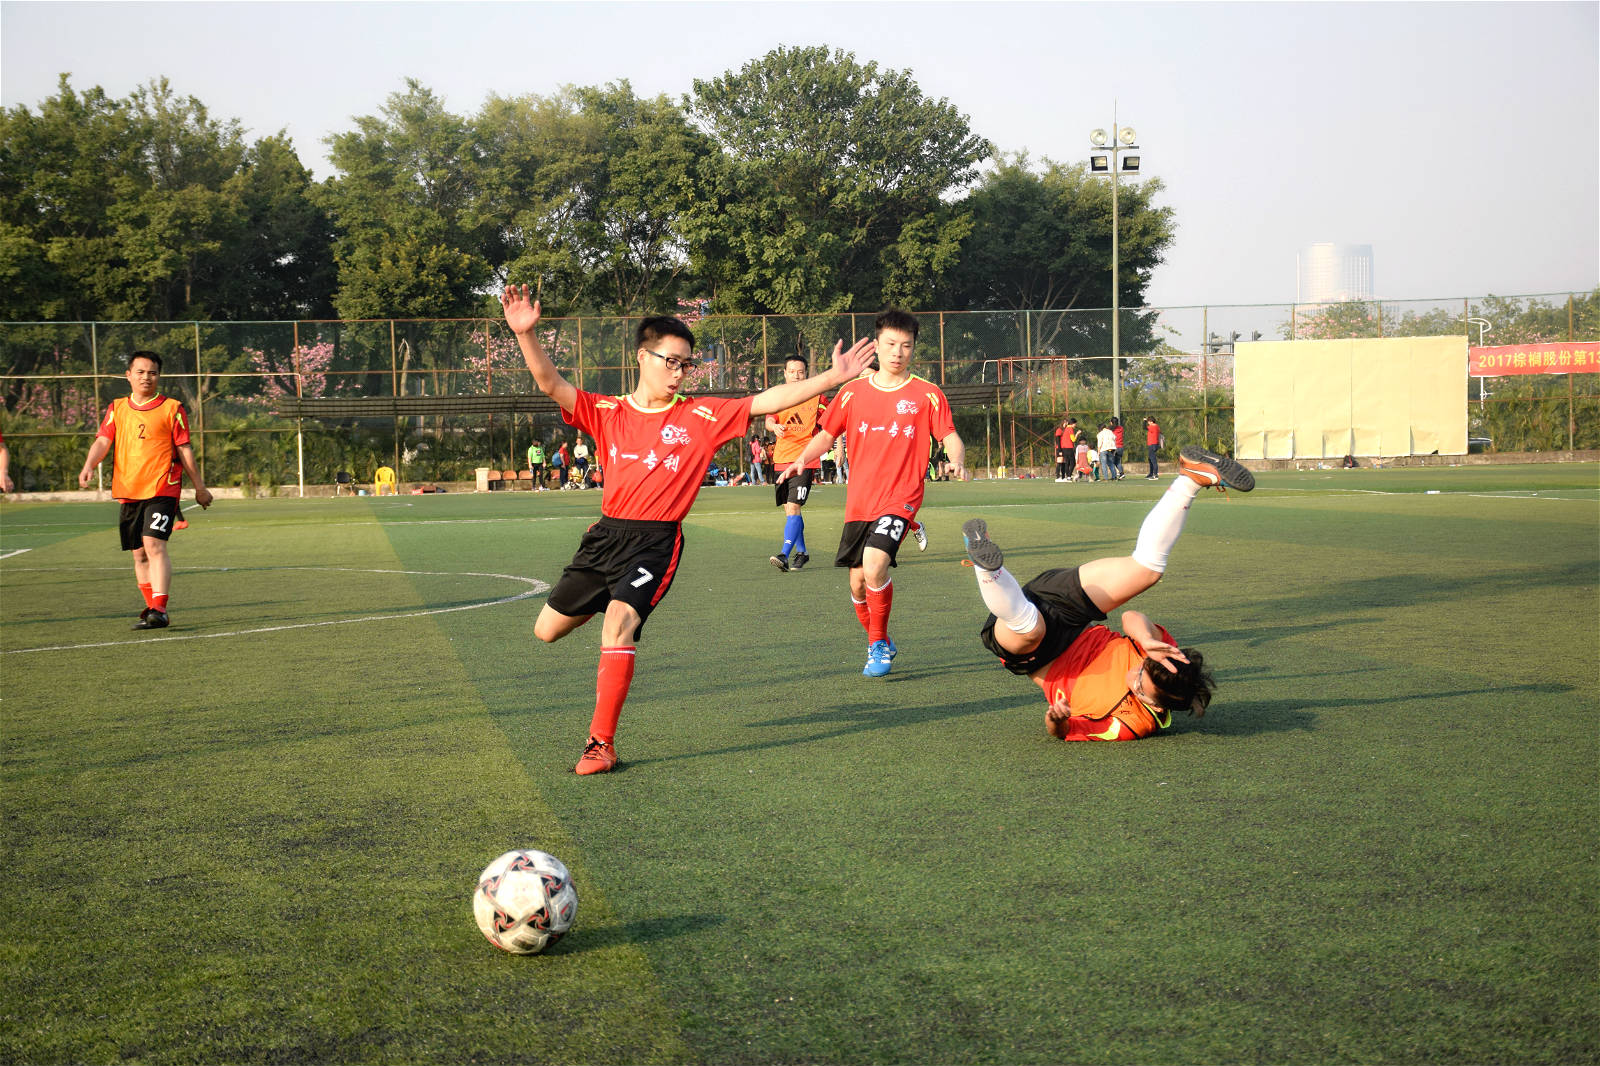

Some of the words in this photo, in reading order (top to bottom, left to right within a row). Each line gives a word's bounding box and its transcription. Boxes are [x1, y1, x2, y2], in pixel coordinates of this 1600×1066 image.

[138, 424, 146, 439] 2
[858, 421, 916, 439] 中一专利
[609, 443, 681, 472] 中一专利
[796, 486, 807, 500] 10
[149, 512, 170, 533] 22
[874, 516, 905, 542] 23
[630, 566, 654, 588] 7
